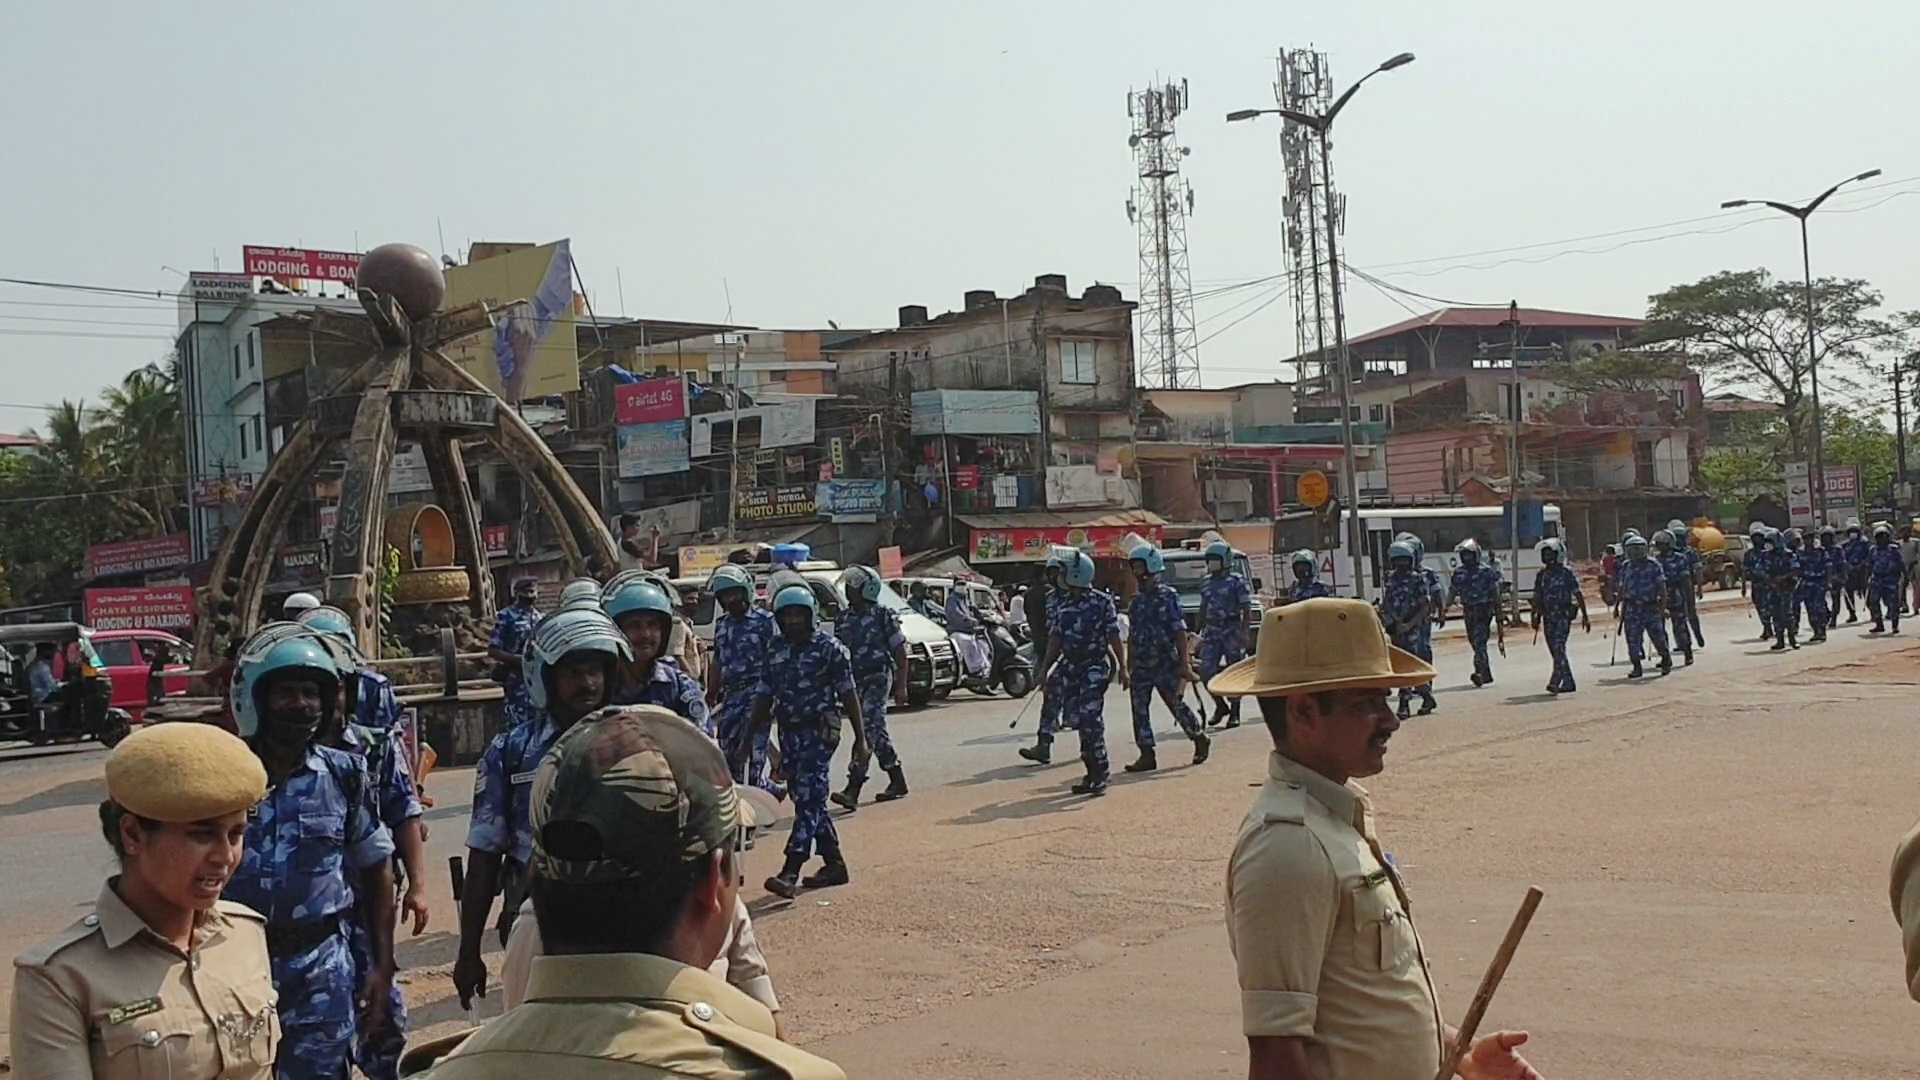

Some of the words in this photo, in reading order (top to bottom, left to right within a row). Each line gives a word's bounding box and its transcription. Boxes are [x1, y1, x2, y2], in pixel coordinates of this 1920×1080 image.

[250, 258, 310, 276] LODGING
[316, 265, 324, 276] &
[329, 264, 358, 280] BOA
[192, 279, 251, 289] LODGING
[635, 391, 658, 407] airtel
[660, 389, 673, 403] 4G
[777, 490, 806, 502] DURGA
[740, 503, 774, 519] PHOTO
[776, 500, 815, 515] STUDIO
[94, 561, 133, 576] LODGING
[143, 554, 189, 568] BOARDING
[92, 606, 127, 616] CHAYA
[130, 604, 188, 614] RESIDENCY
[91, 616, 133, 630] LODGING
[144, 613, 191, 627] BOARDING
